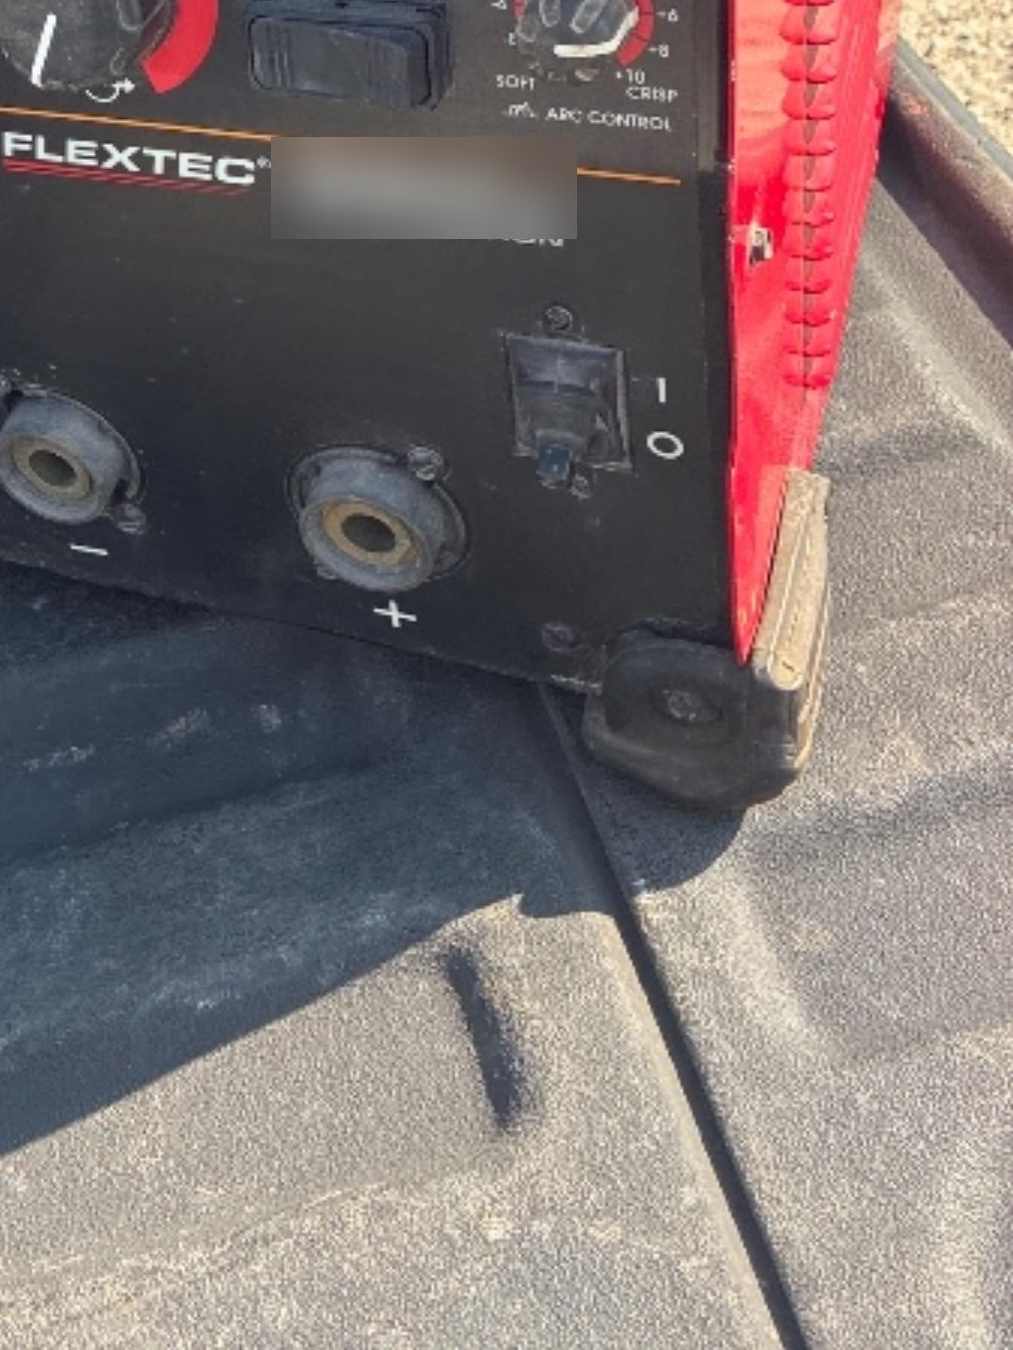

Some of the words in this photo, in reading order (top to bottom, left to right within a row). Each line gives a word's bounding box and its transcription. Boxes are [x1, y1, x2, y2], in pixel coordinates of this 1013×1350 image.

[496, 74, 535, 91] SOFT
[625, 86, 679, 103] CRISP
[545, 107, 583, 124] ARC
[587, 110, 672, 131] CONTROL
